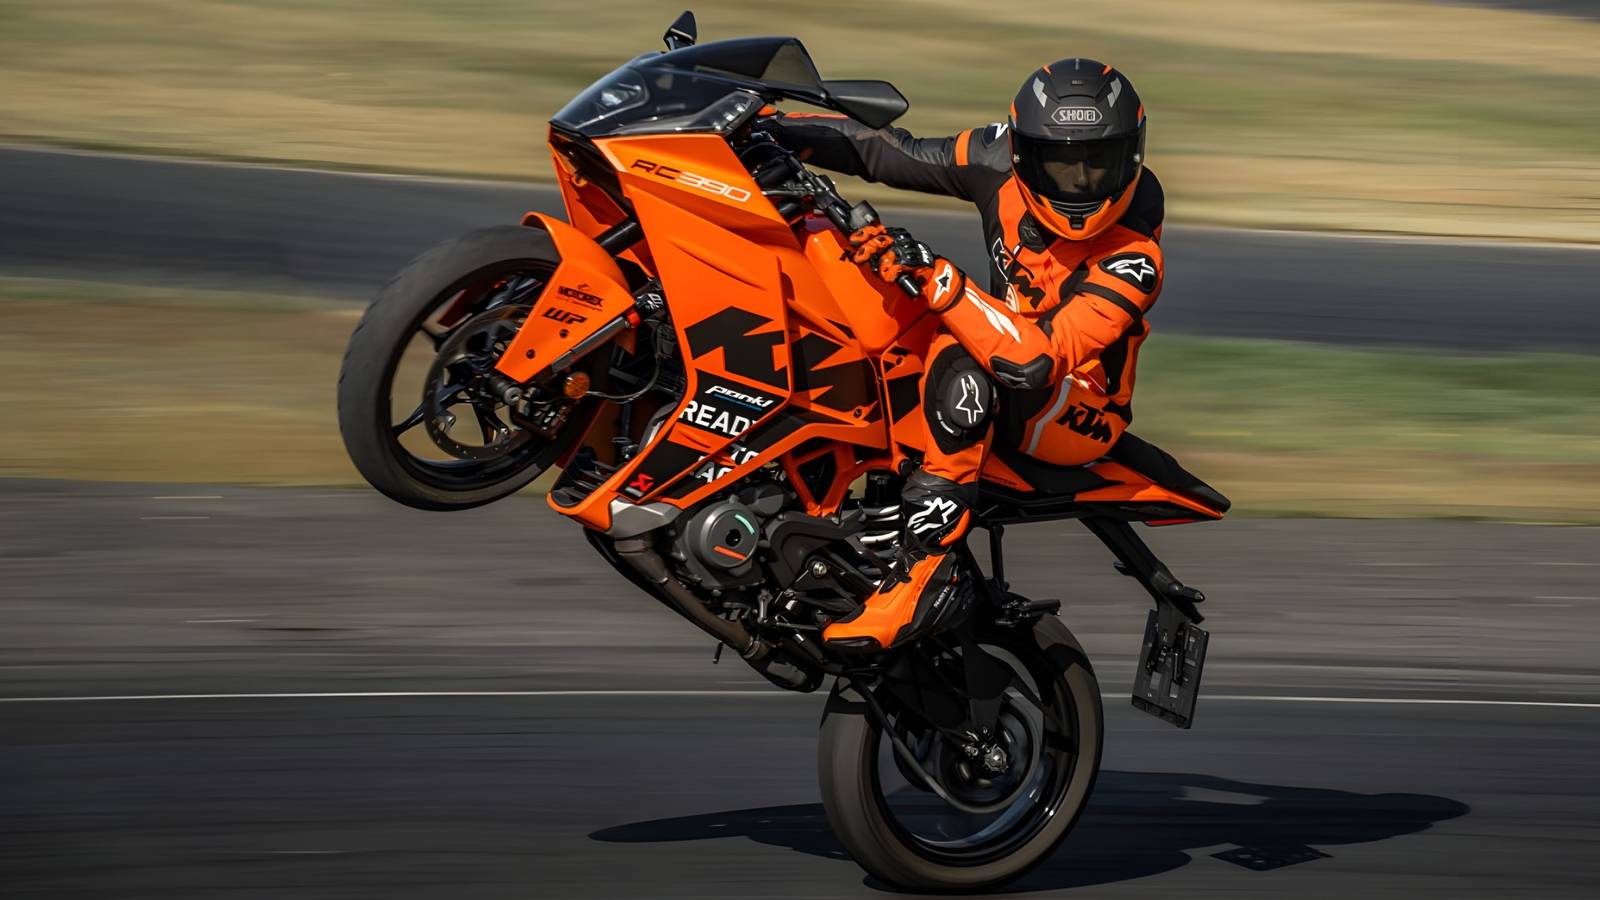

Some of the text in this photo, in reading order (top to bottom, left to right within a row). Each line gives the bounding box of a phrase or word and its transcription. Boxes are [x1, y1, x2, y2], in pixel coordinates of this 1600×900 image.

[542, 307, 588, 325] WP
[679, 399, 758, 437] READ
[1056, 401, 1113, 444] KTM
